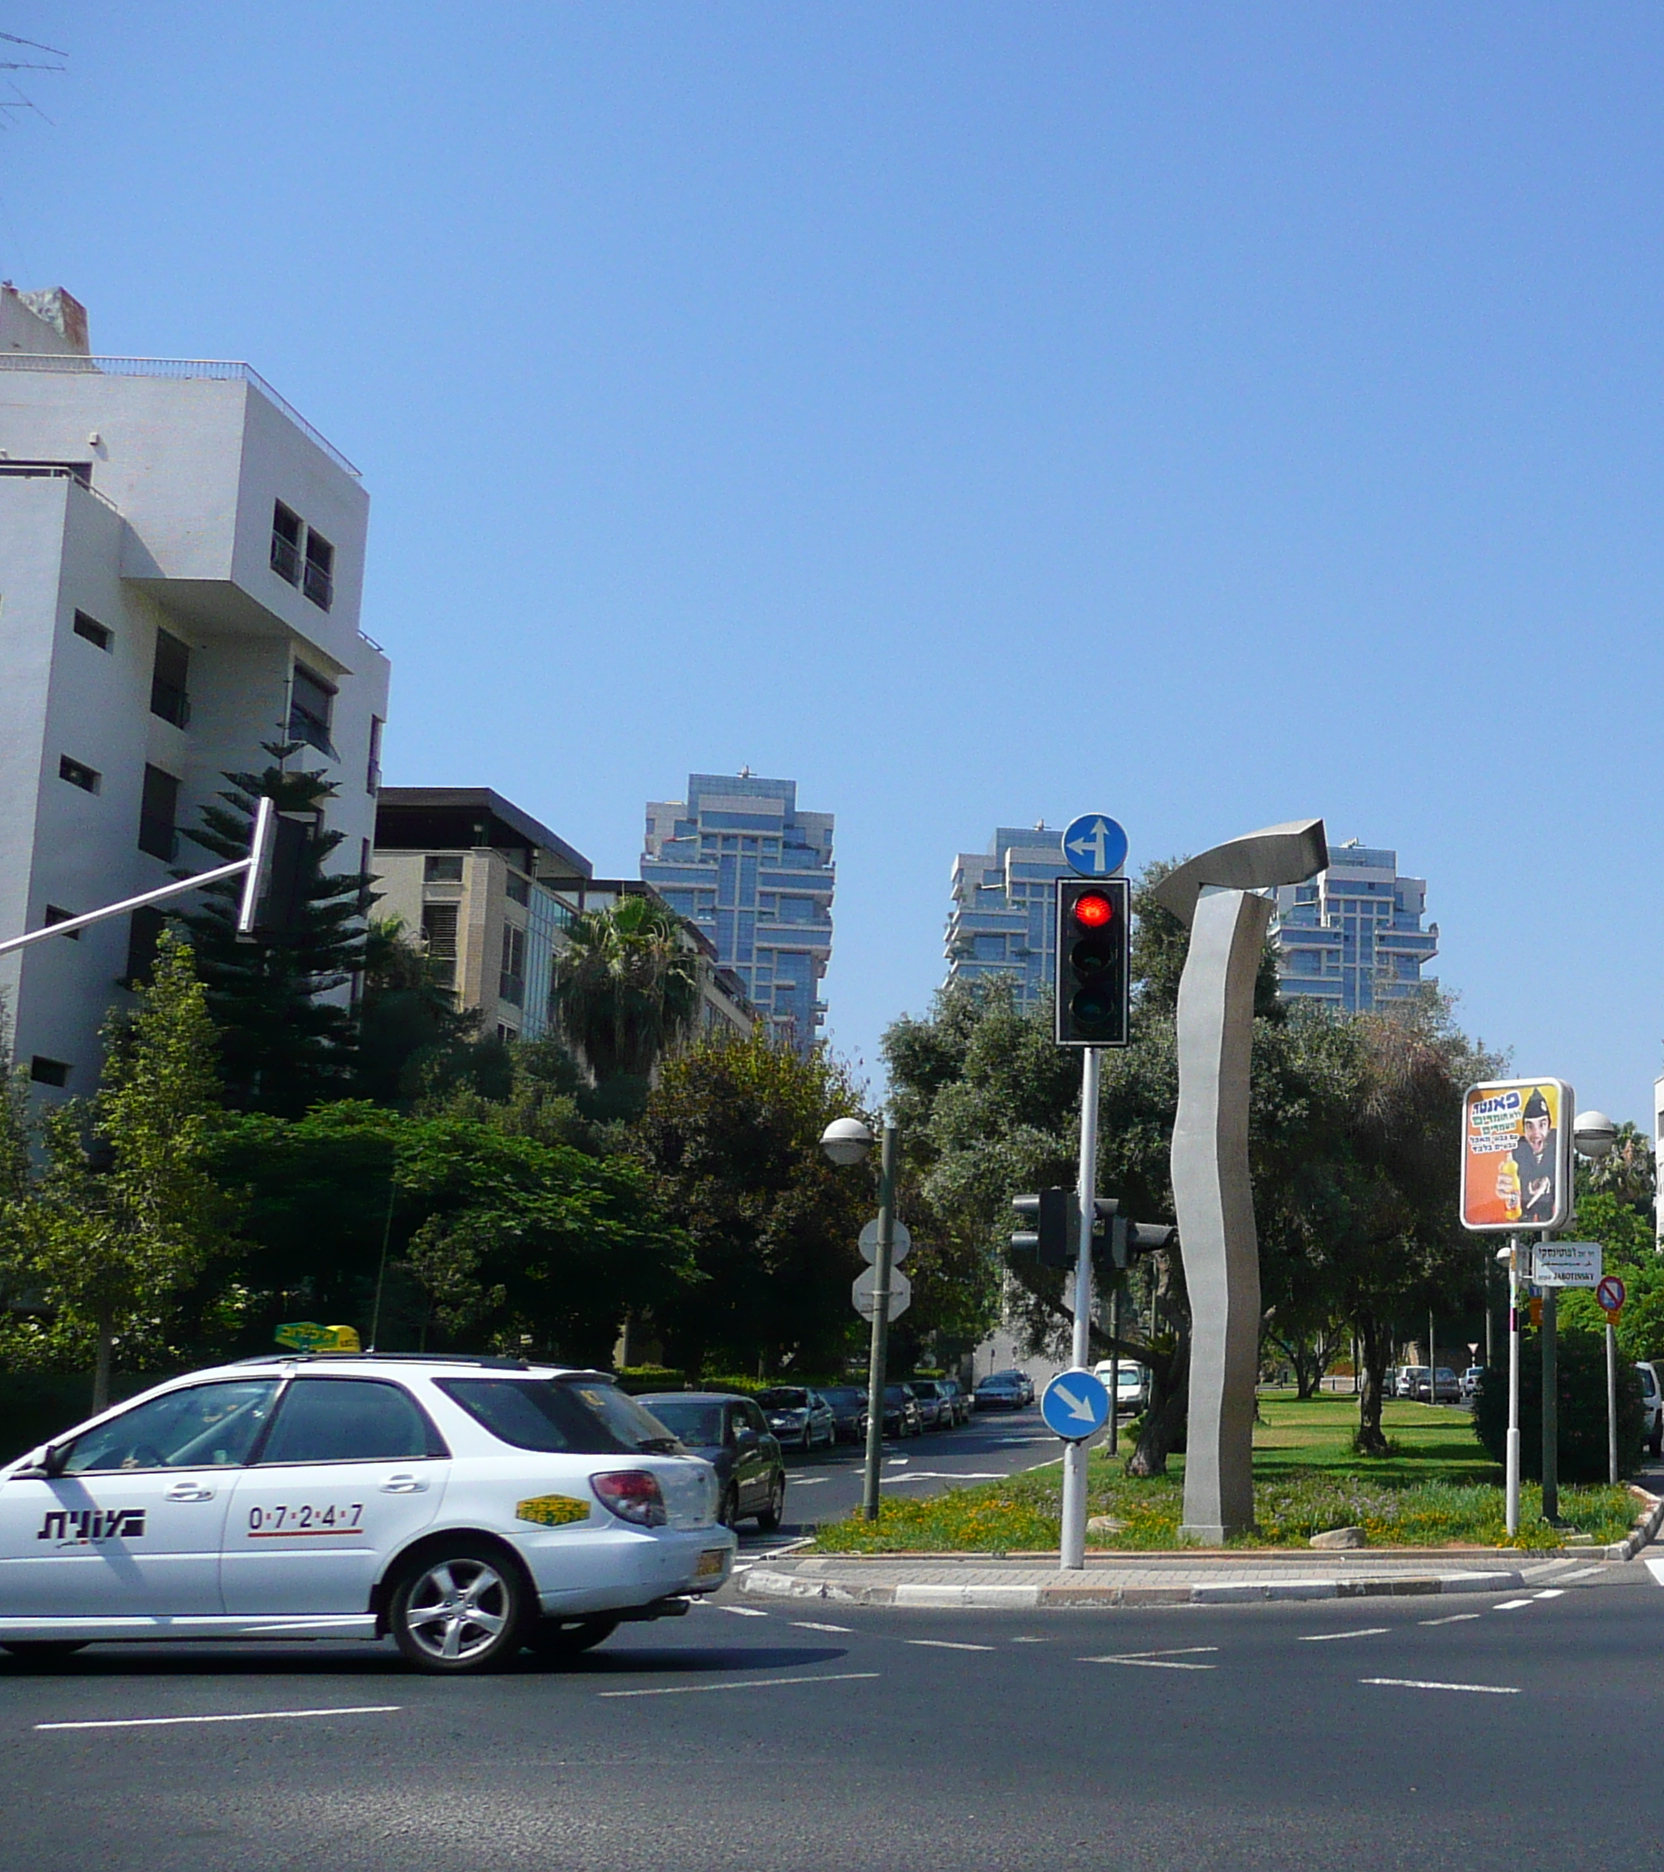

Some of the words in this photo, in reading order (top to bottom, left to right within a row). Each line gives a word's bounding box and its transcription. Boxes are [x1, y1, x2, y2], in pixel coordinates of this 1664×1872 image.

[1472, 1092, 1520, 1115] פאנטה
[1472, 1113, 1508, 1126] חומרים
[1553, 1272, 1594, 1281] JABOTINSKY
[37, 1508, 146, 1540] מונית
